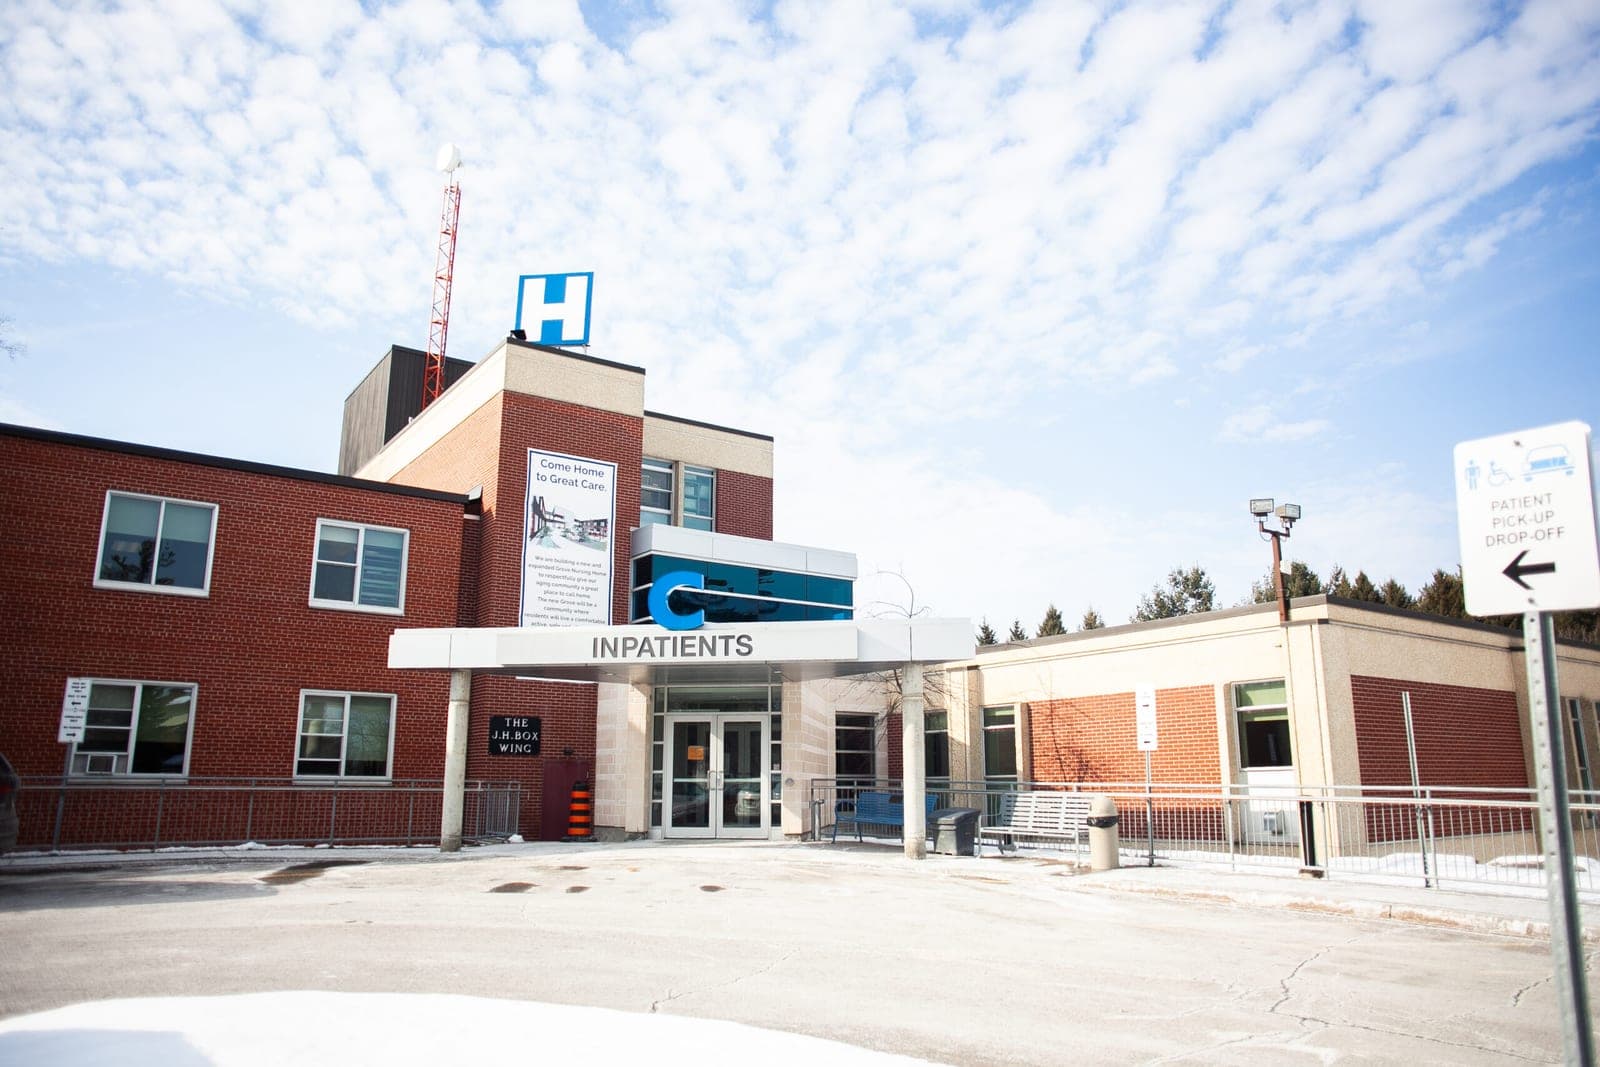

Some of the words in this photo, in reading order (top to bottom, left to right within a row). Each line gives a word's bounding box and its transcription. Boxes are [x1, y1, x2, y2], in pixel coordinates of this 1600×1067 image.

[521, 275, 588, 342] H
[540, 459, 572, 473] Come
[574, 464, 605, 477] Home
[536, 471, 547, 482] to
[549, 474, 578, 487] Great
[581, 479, 607, 492] Care.
[1491, 492, 1553, 512] PATIENT
[1492, 510, 1555, 529] PICK-UP
[1485, 526, 1565, 547] DROP-OFF
[554, 558, 575, 566] building
[572, 568, 591, 576] Nursing
[552, 582, 580, 591] community
[648, 570, 704, 631] C
[543, 606, 573, 614] community
[592, 634, 754, 658] INPATIENTS
[504, 717, 529, 728] THE
[499, 743, 532, 753] WING
